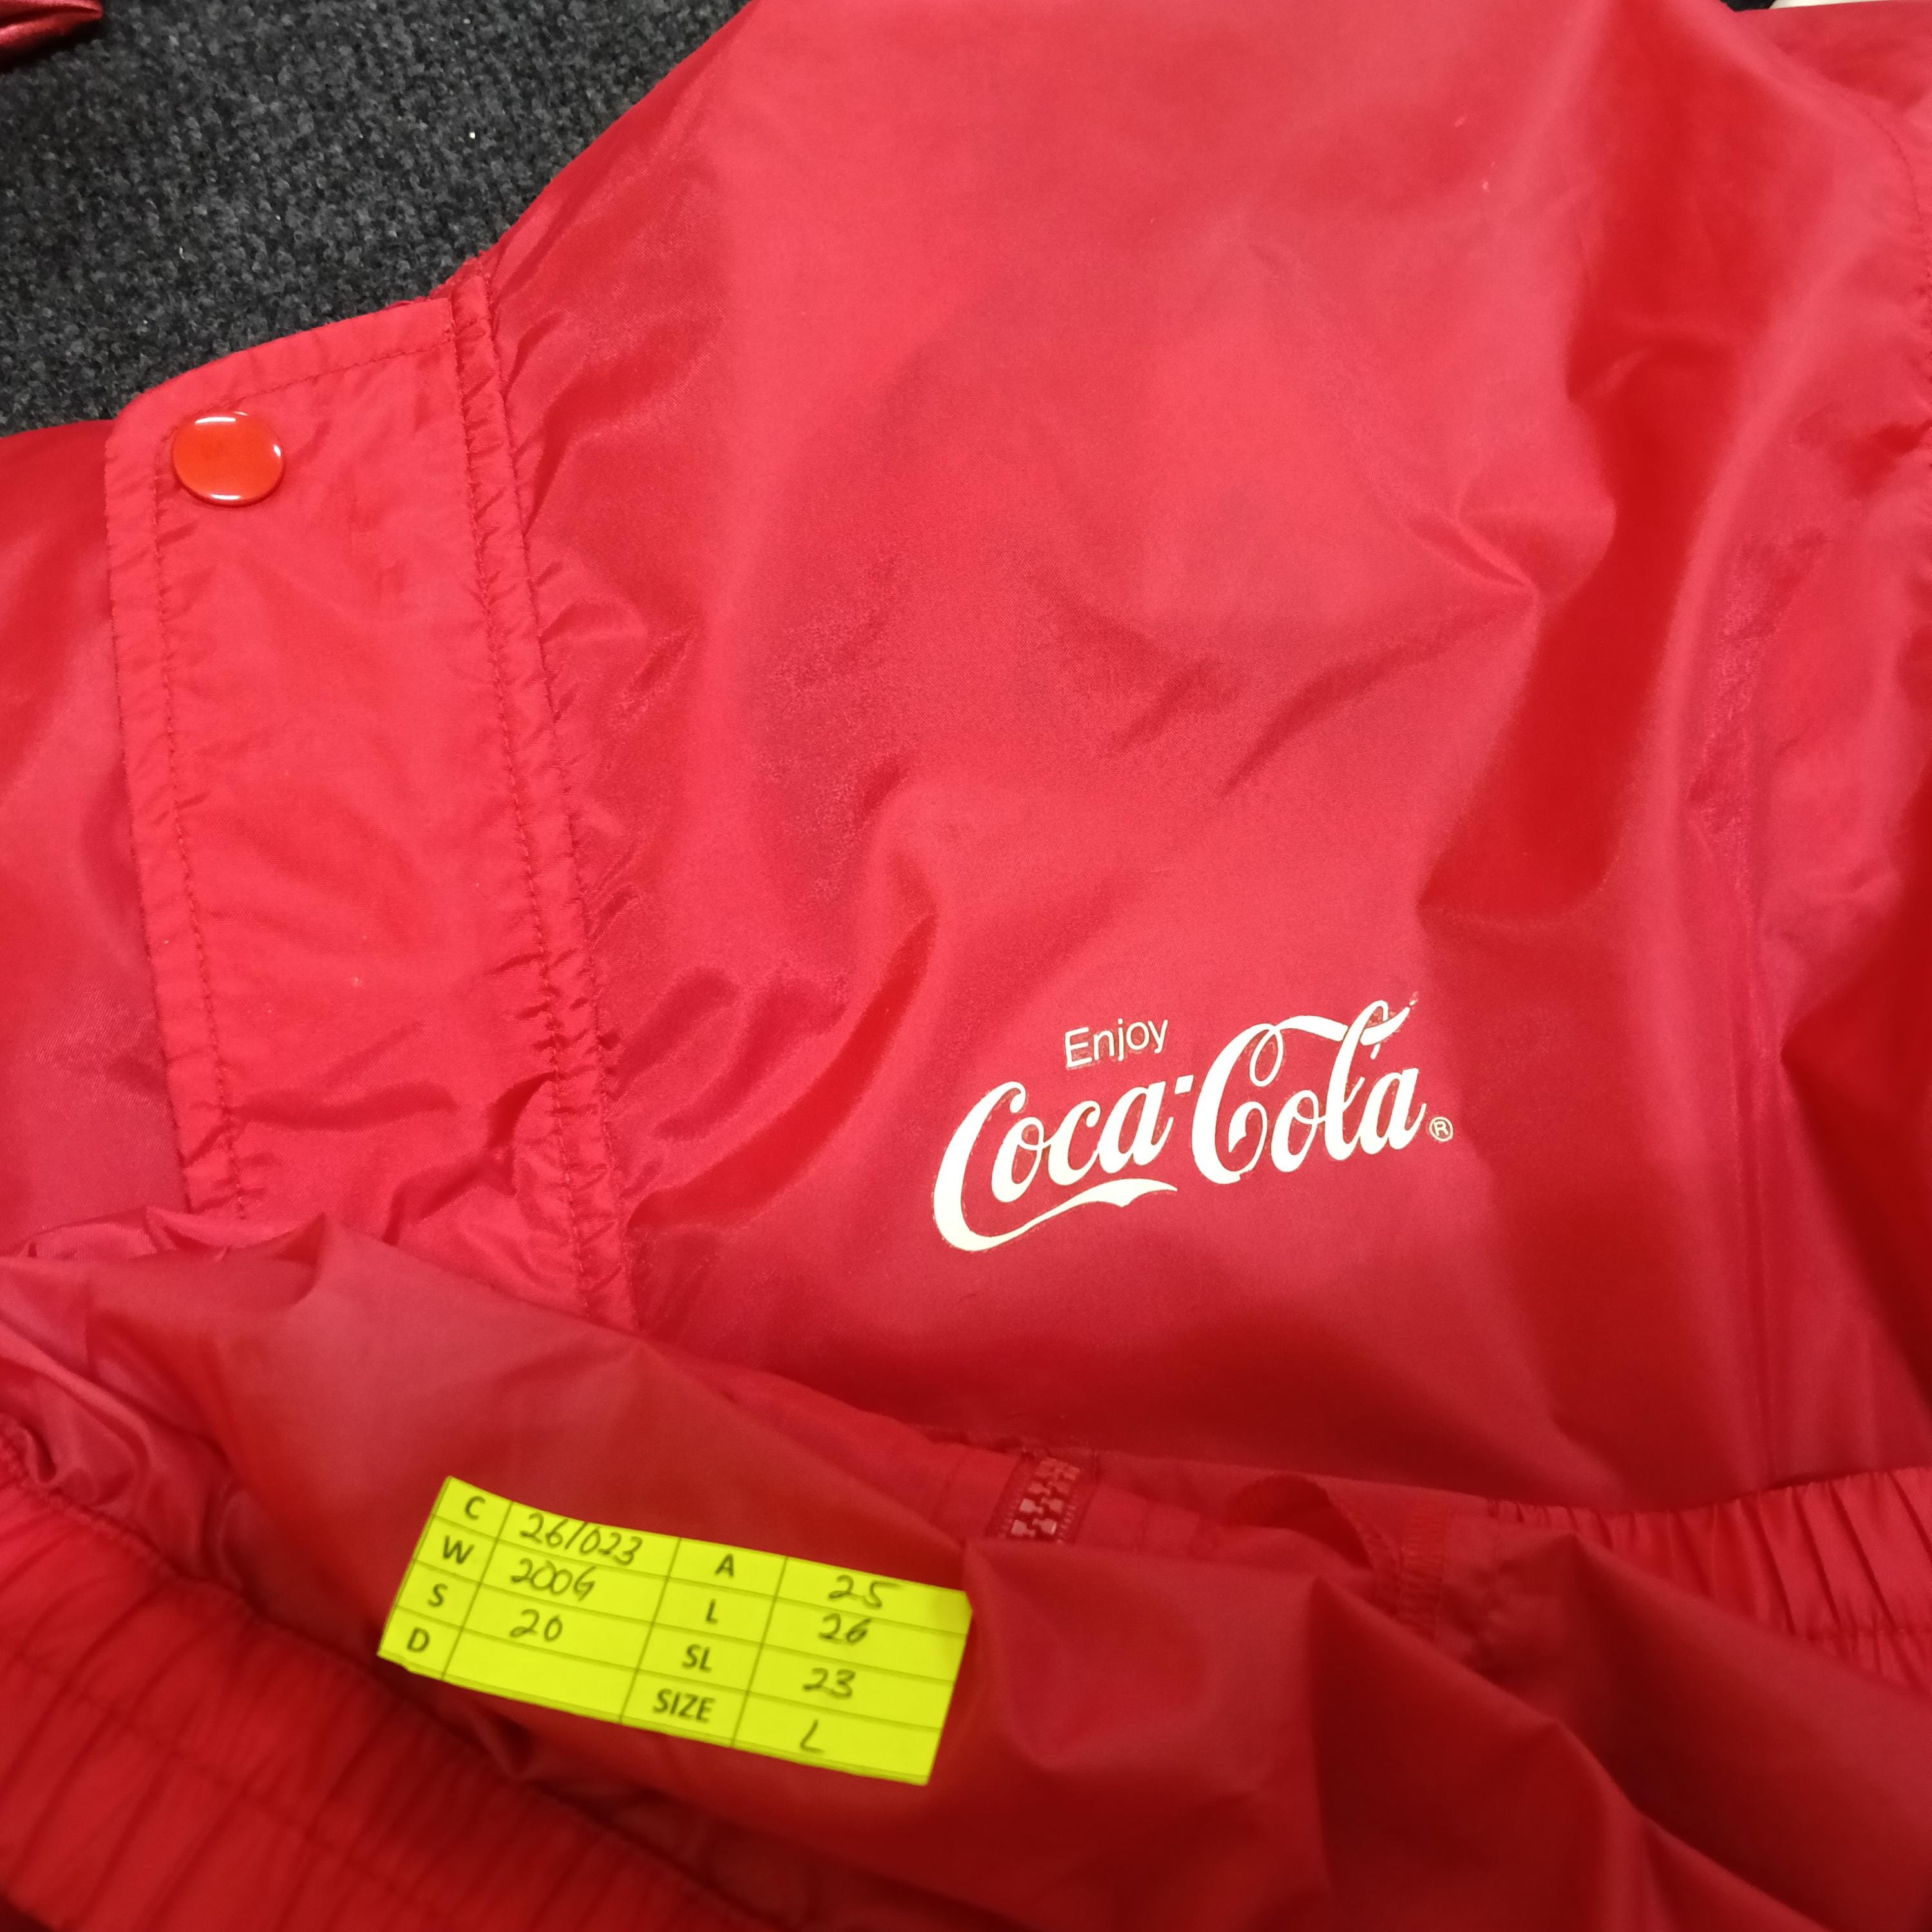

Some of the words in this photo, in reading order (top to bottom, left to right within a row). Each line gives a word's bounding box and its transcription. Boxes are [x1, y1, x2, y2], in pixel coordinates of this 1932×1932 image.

[1065, 1018, 1168, 1069] Enjoy
[933, 992, 1426, 1251] Coca-Cola
[464, 1496, 486, 1520] C
[442, 1535, 474, 1565] W
[520, 1512, 643, 1567] 26/023
[715, 1553, 737, 1578] A
[426, 1583, 448, 1607] S
[827, 1574, 903, 1610] 25
[509, 1608, 564, 1643] 20
[705, 1598, 719, 1624] L
[407, 1627, 430, 1653] D
[818, 1613, 869, 1644] 26
[681, 1644, 713, 1672] SL
[802, 1667, 856, 1700] 23
[653, 1688, 716, 1723] SIZE
[799, 1719, 826, 1754] L
